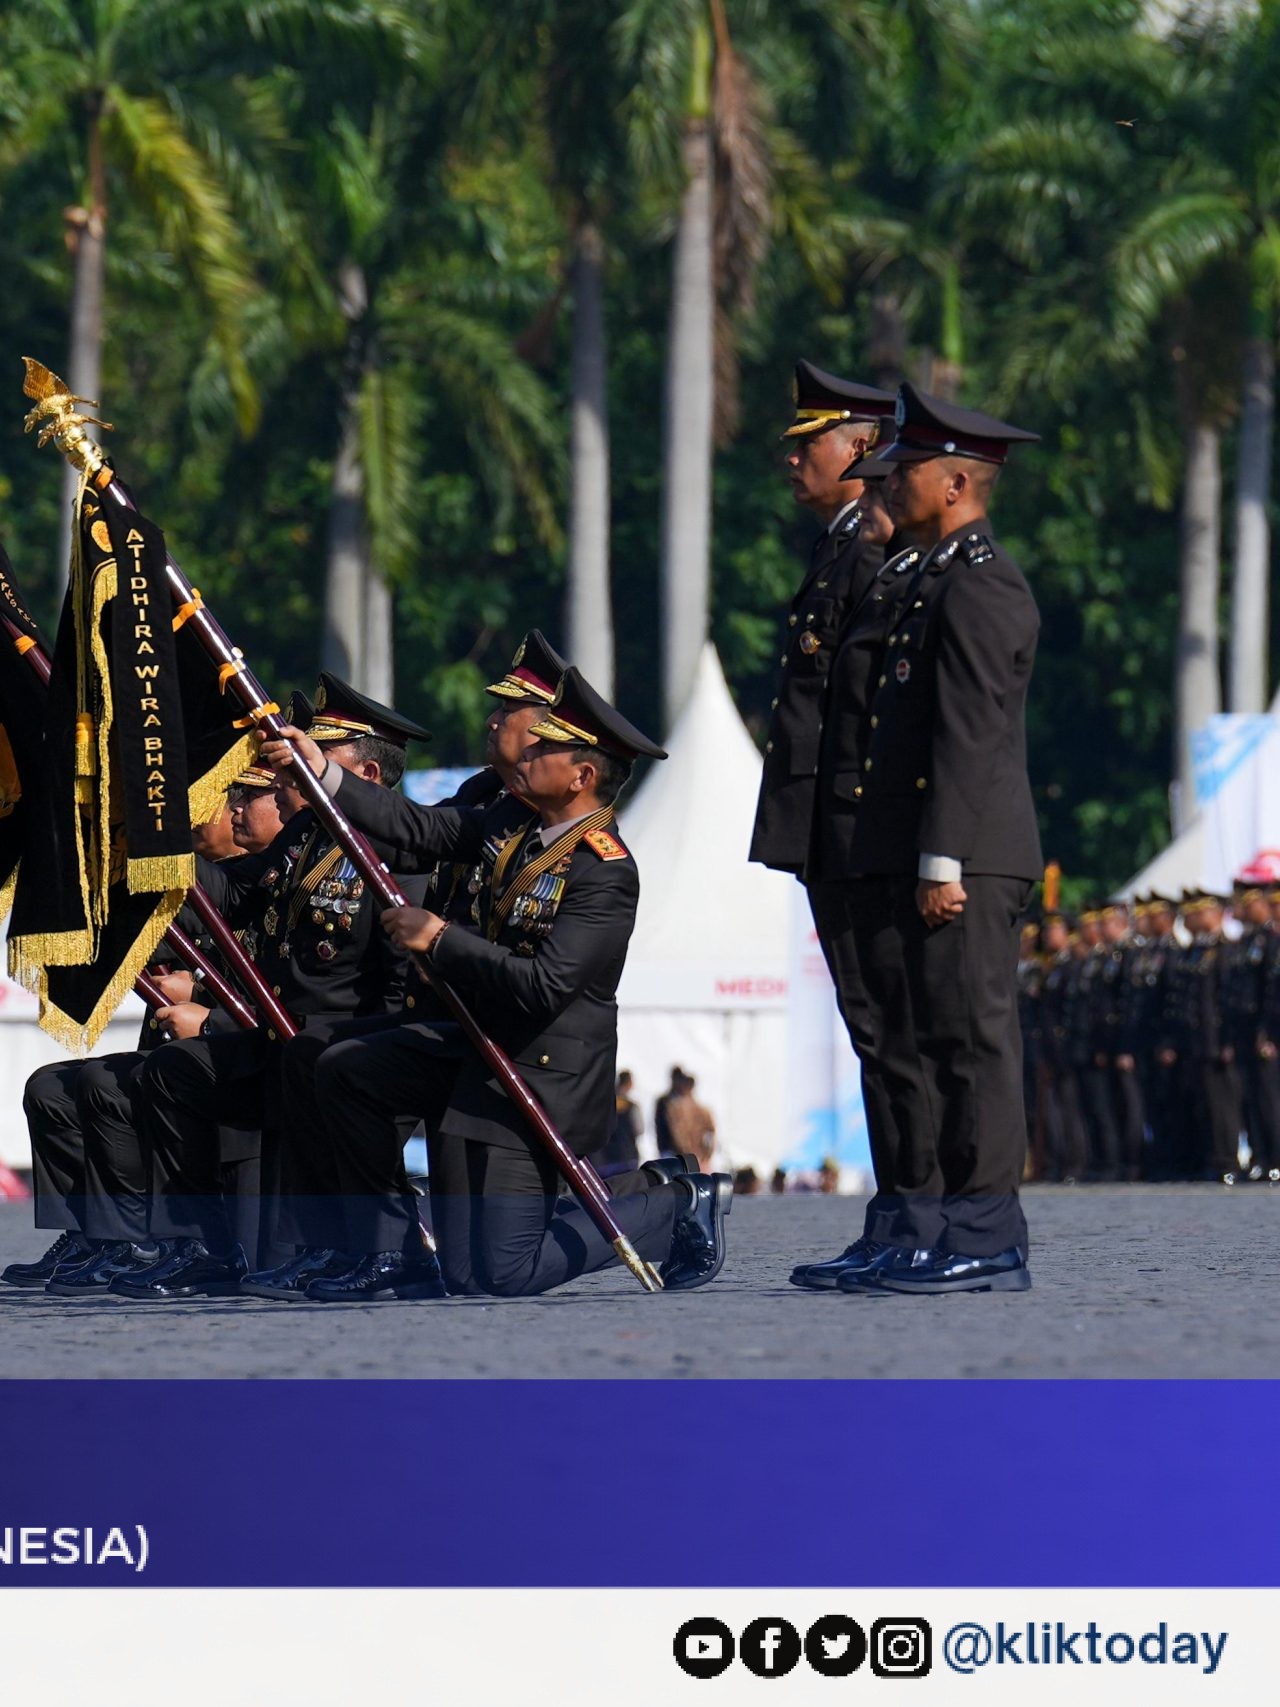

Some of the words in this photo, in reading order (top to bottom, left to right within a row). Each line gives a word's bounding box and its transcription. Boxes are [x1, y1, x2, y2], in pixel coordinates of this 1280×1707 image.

[126, 528, 154, 655] ATIDHIRA
[134, 664, 161, 728] WIRA
[144, 737, 166, 832] BHAKTI
